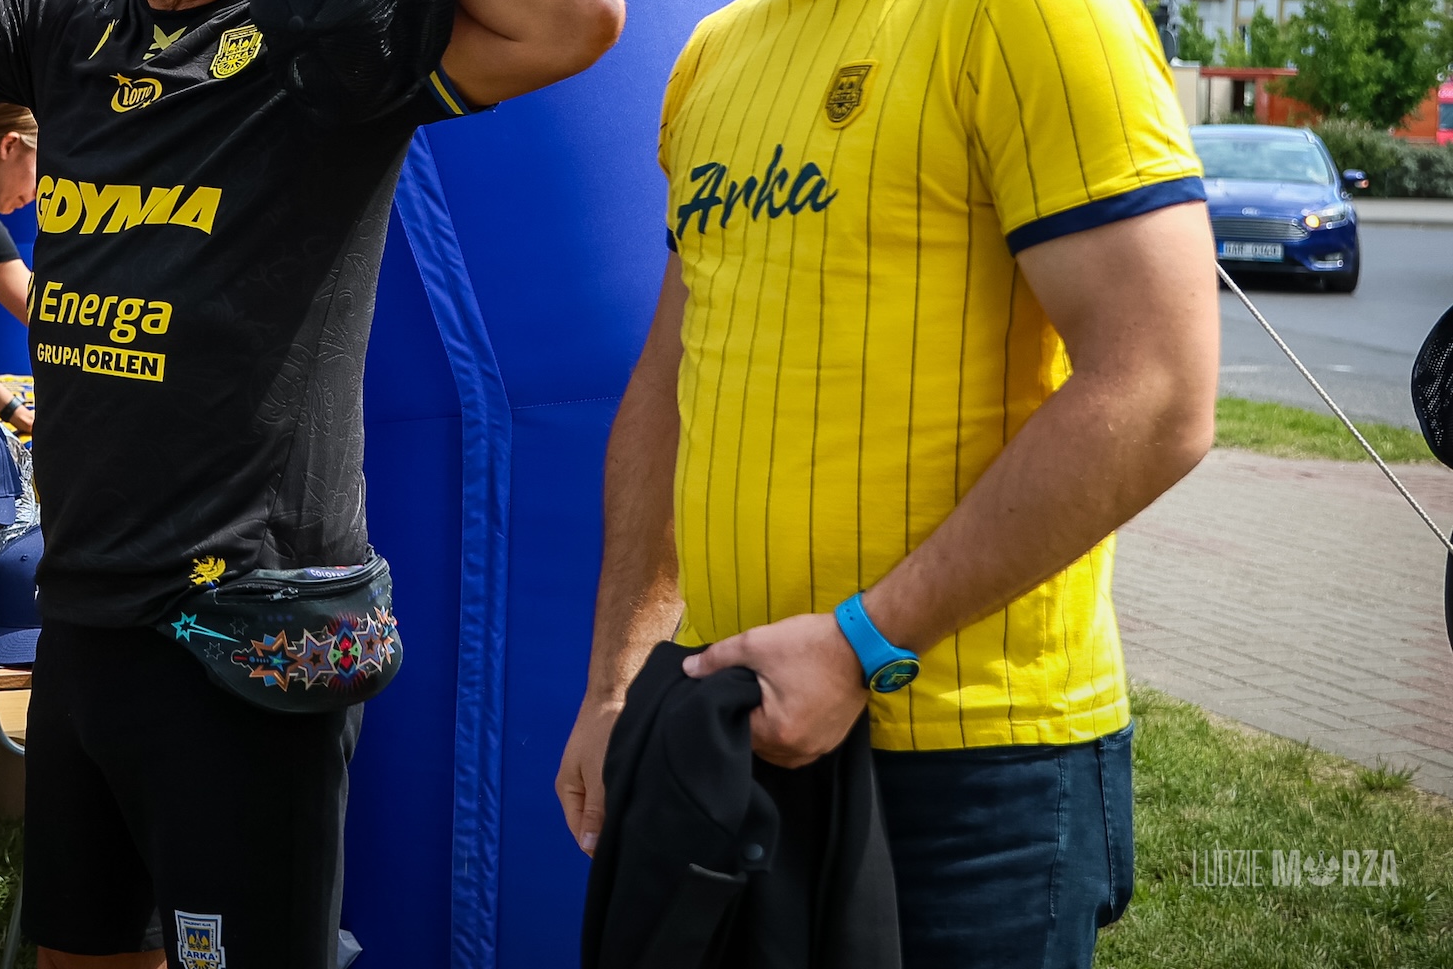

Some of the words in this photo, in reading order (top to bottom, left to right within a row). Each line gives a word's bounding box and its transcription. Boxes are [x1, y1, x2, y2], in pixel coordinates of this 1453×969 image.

[122, 84, 154, 106] LOTTO
[677, 144, 839, 240] Arka
[38, 281, 174, 344] Energa
[36, 343, 82, 369] GRUPA
[86, 347, 160, 378] ORLEN
[186, 950, 216, 961] ARKA
